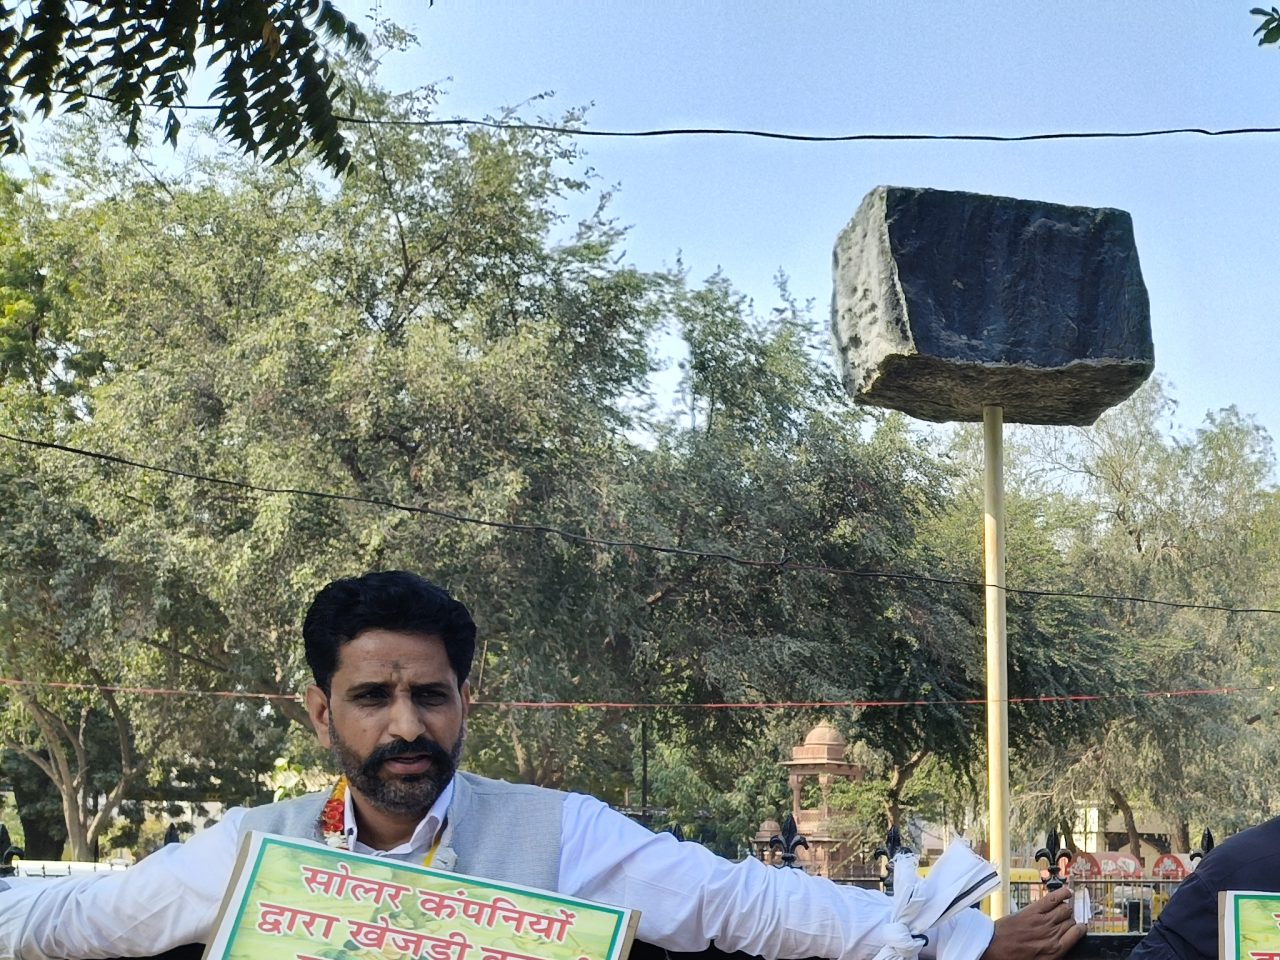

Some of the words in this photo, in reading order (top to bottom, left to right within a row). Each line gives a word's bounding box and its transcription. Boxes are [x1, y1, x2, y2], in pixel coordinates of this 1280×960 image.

[258, 903, 340, 939] द्वारा
[303, 864, 410, 909] सोलर
[420, 889, 575, 942] कंपनियों
